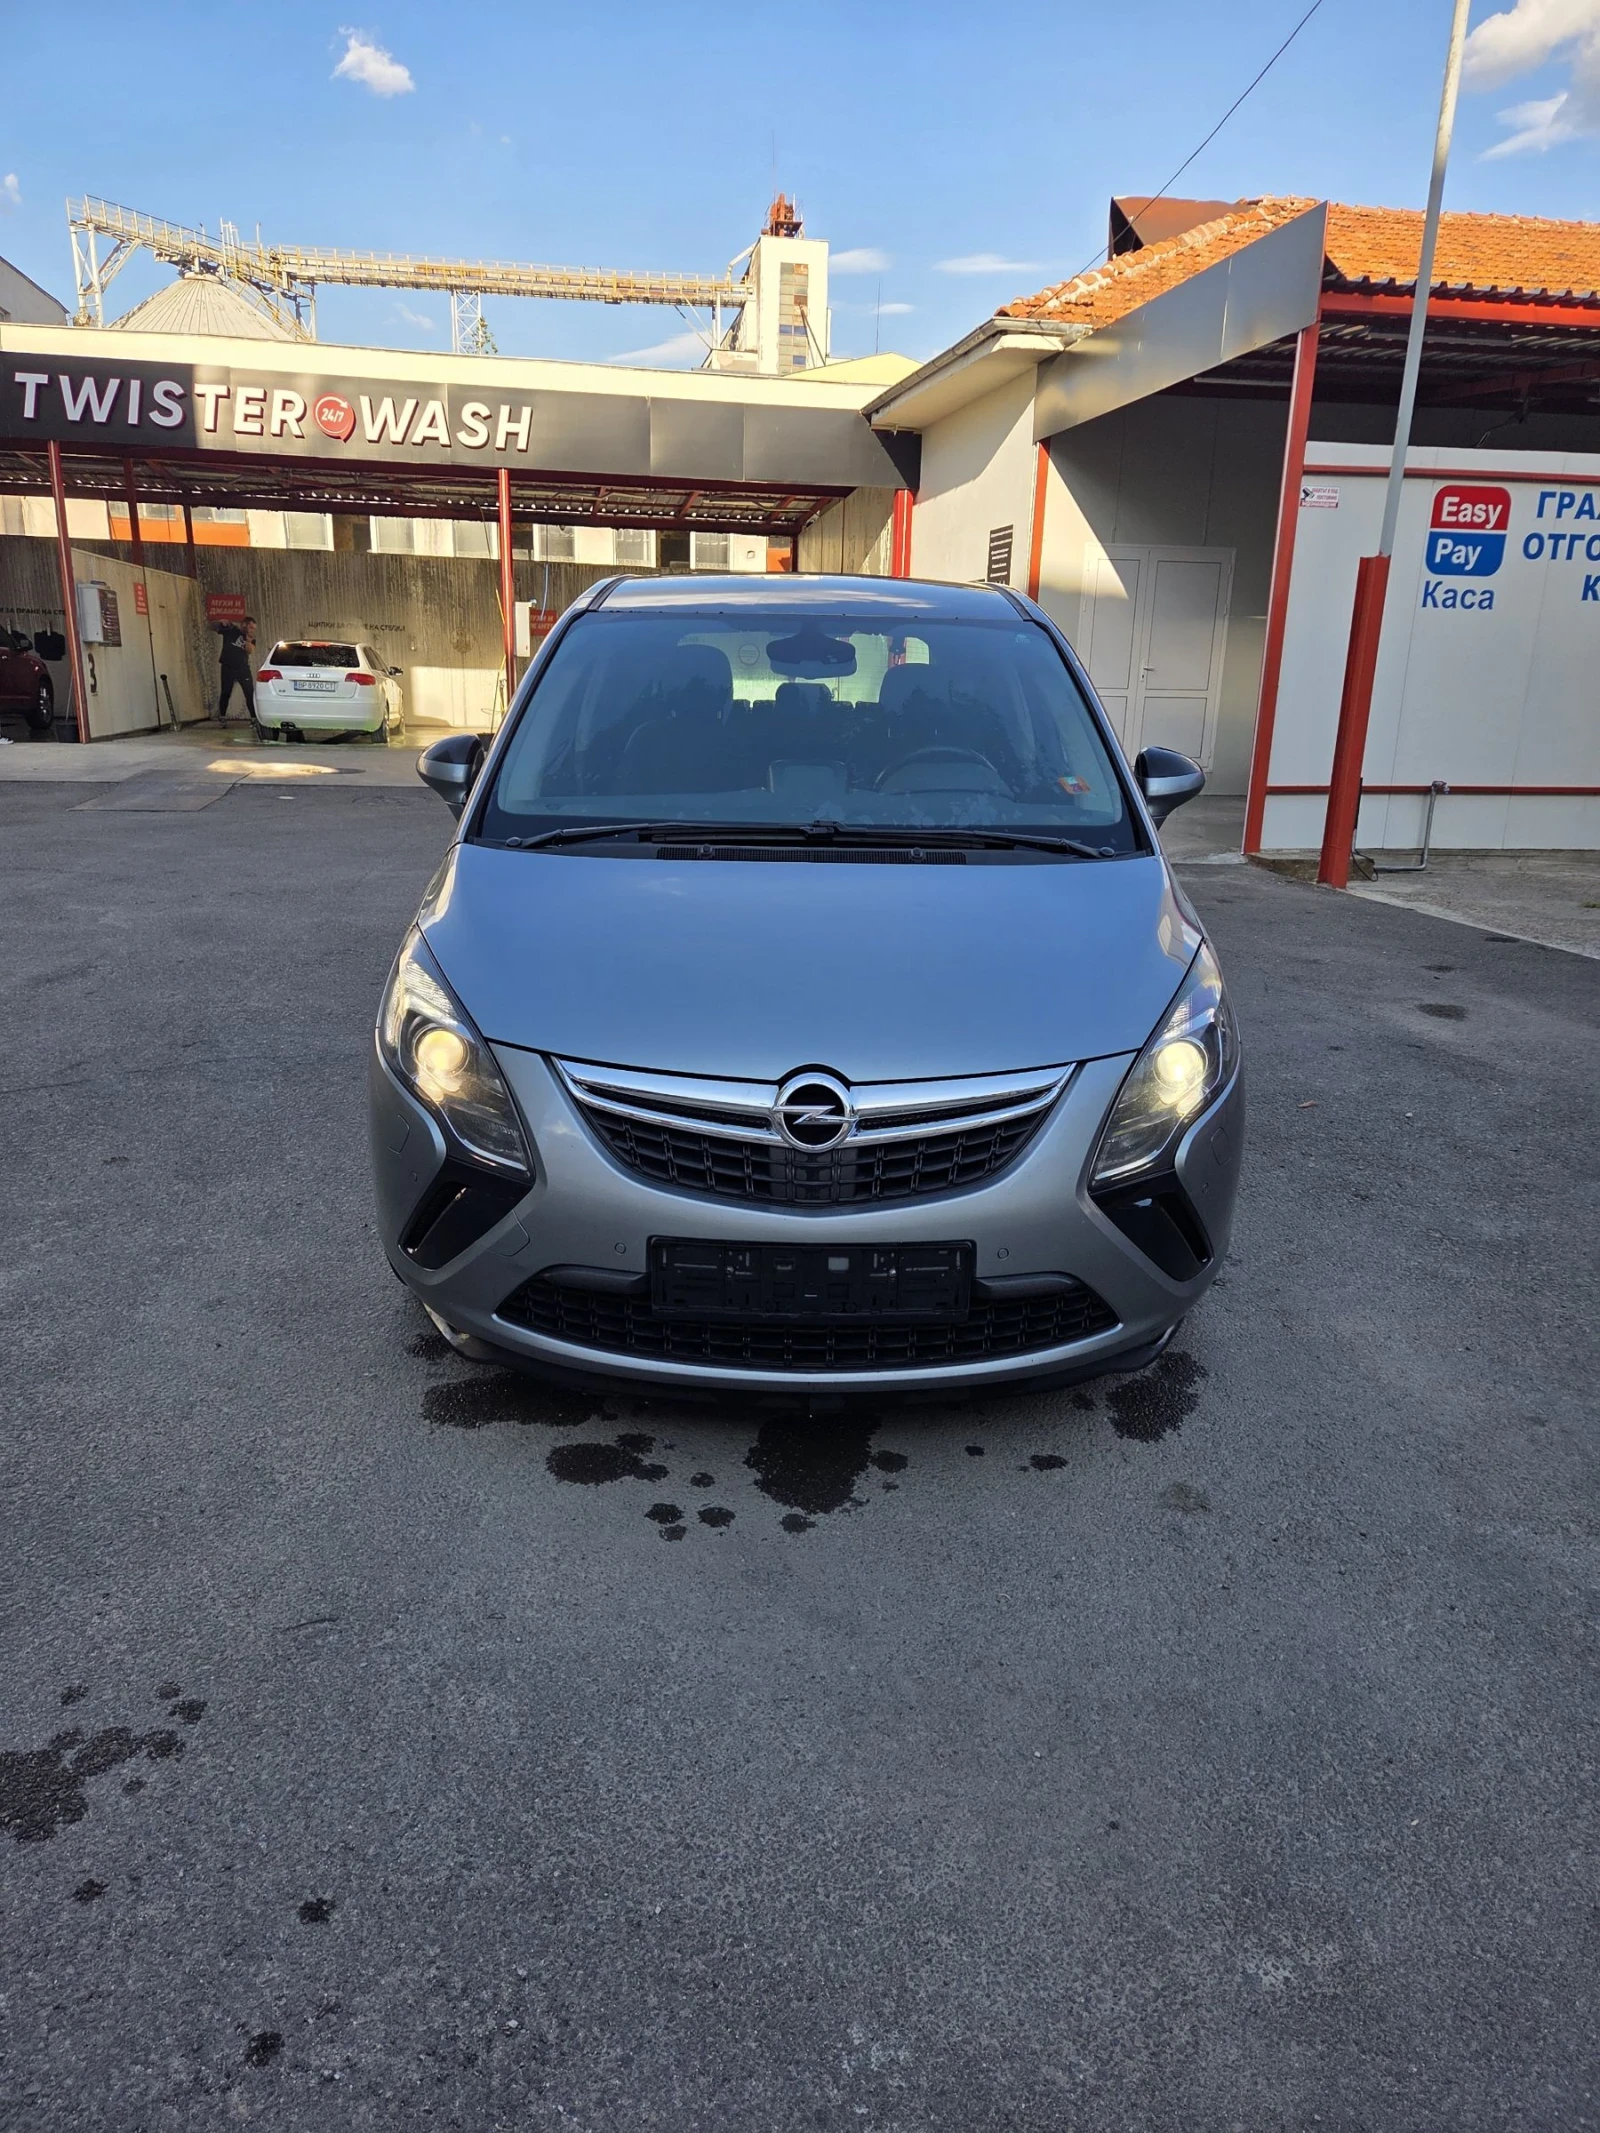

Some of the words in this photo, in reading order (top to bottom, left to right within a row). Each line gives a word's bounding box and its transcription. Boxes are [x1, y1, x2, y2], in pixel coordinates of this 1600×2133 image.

[14, 371, 307, 439] TWISTER
[321, 407, 345, 423] 24/7
[359, 395, 533, 453] WASH
[1440, 496, 1503, 530] Easy
[1536, 491, 1600, 520] ГРА
[1434, 538, 1483, 571] Pay
[1421, 580, 1495, 610] Каса
